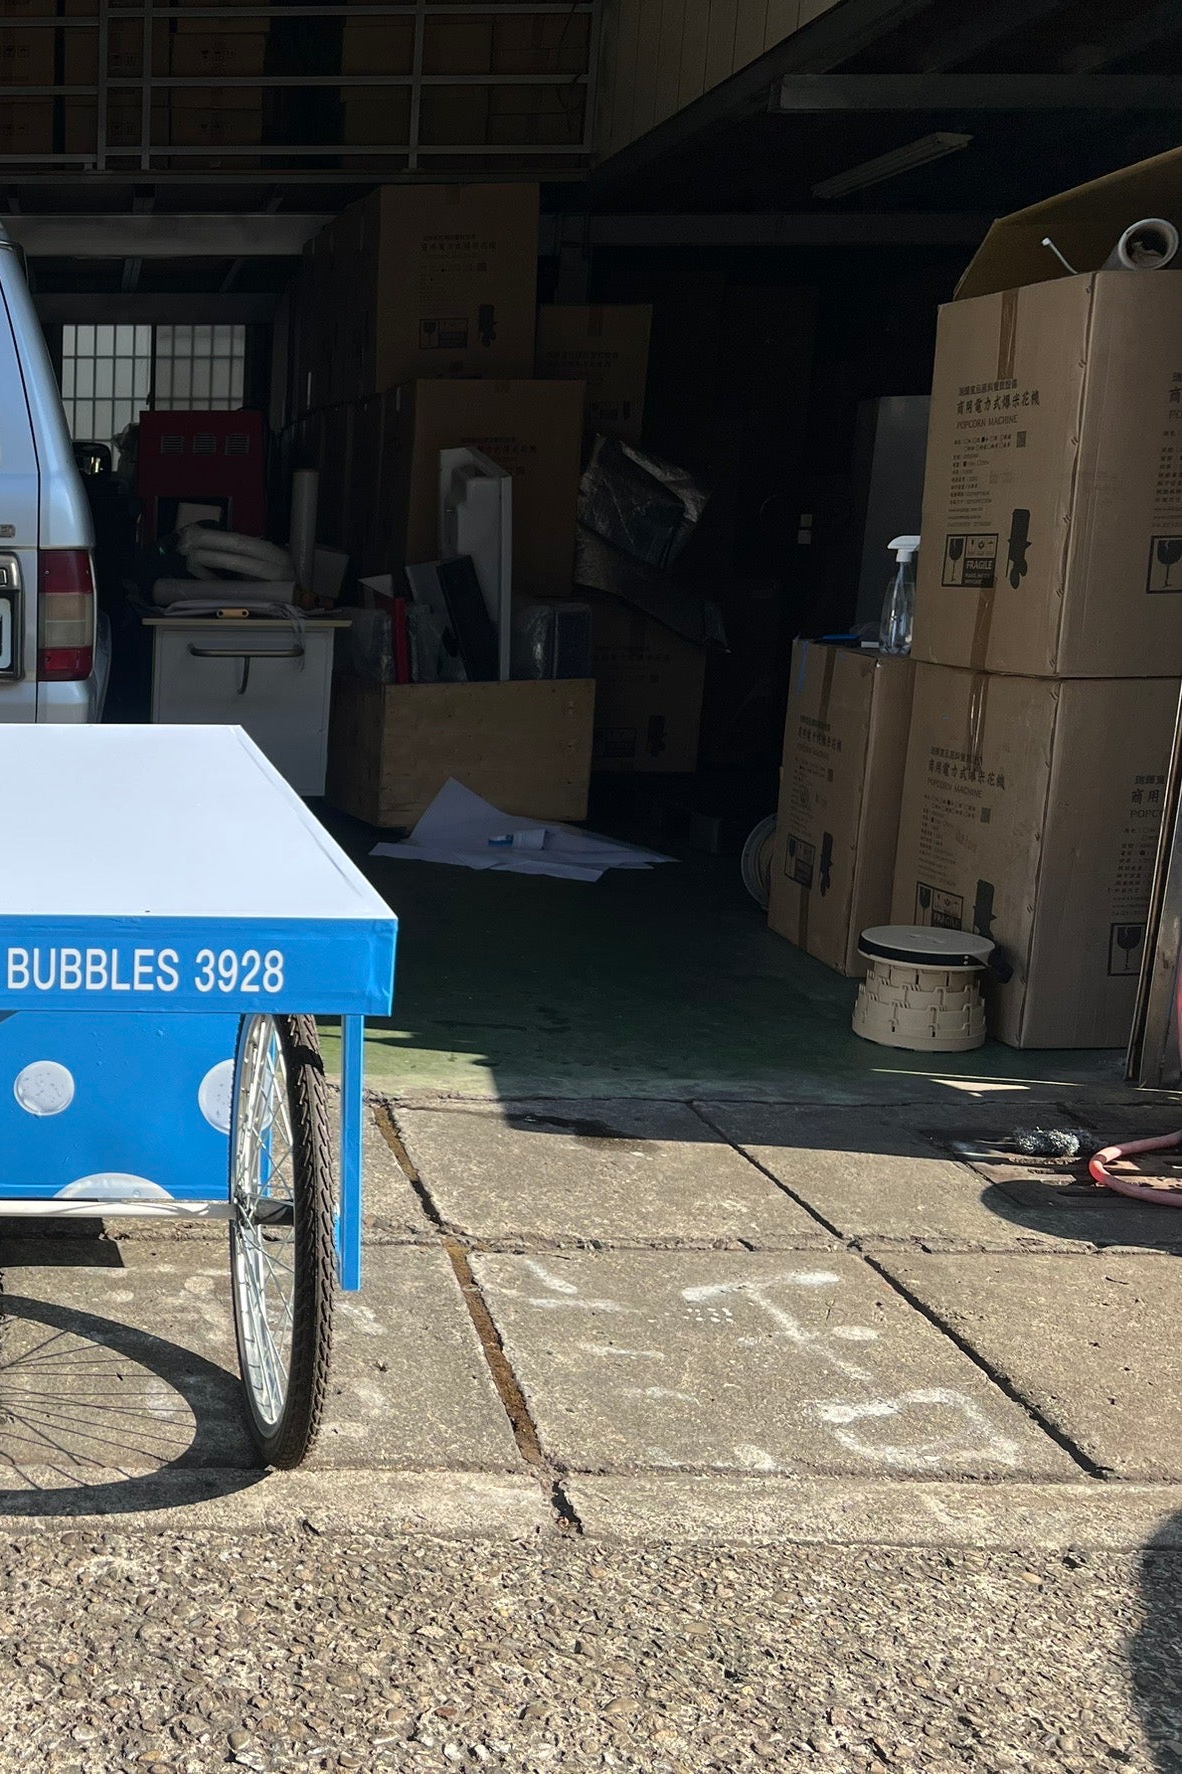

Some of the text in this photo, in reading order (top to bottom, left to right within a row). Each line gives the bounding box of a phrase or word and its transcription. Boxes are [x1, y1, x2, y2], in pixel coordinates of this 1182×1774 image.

[956, 414, 1018, 430] POPCORN MACHINE
[965, 560, 993, 571] FRAGILE
[6, 947, 179, 993] BUBBLES
[194, 949, 284, 994] 3928
